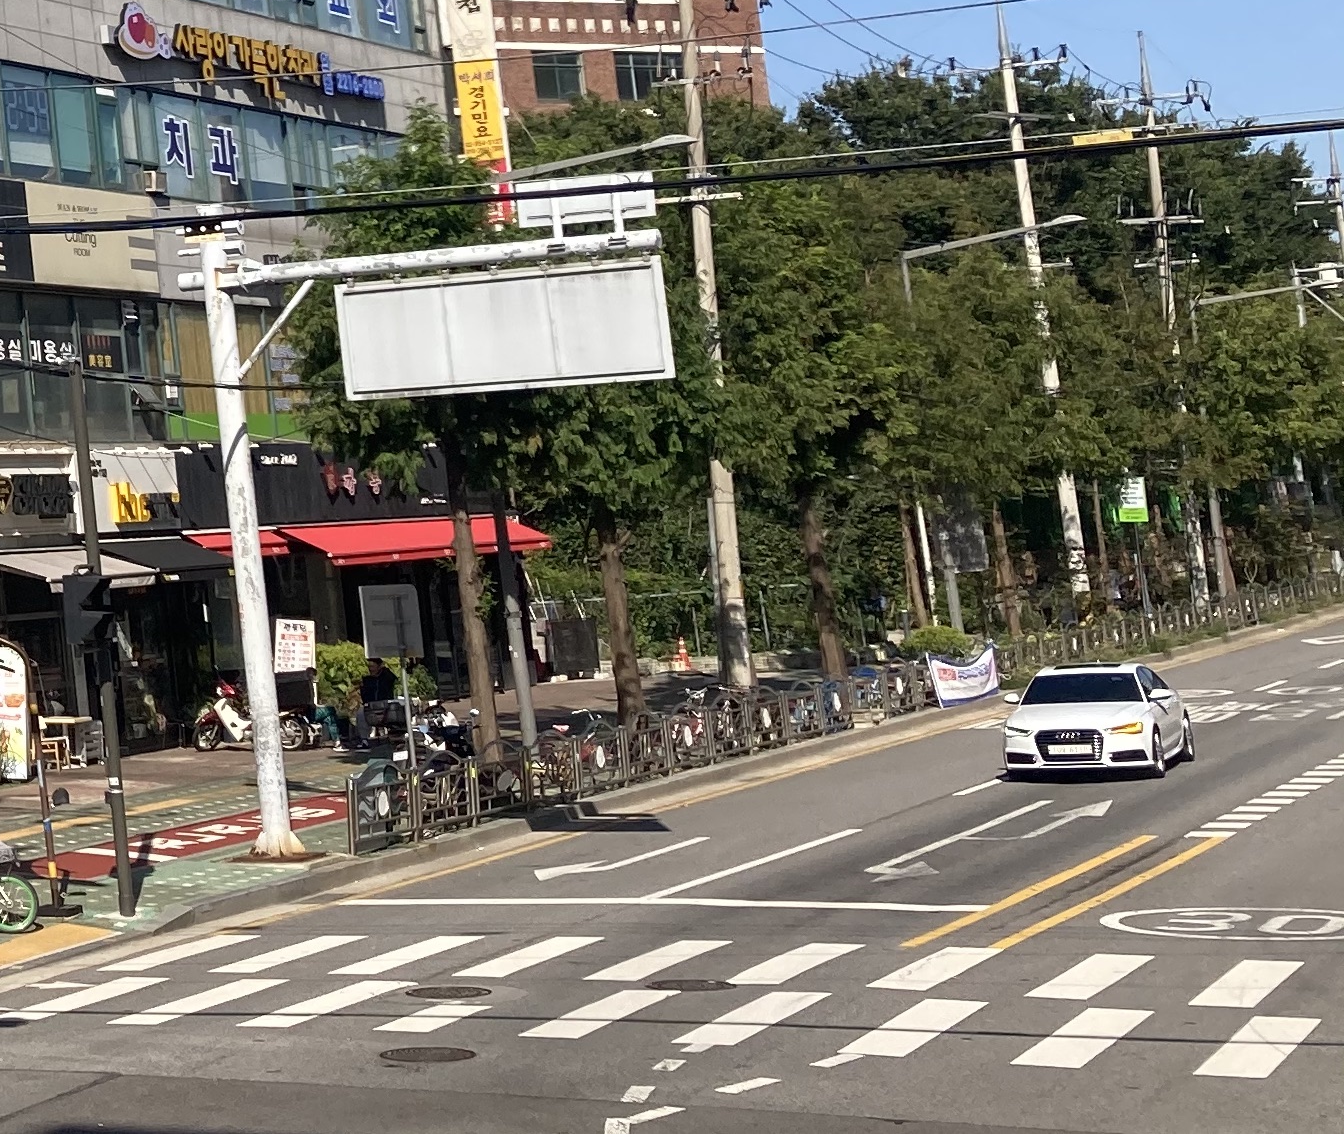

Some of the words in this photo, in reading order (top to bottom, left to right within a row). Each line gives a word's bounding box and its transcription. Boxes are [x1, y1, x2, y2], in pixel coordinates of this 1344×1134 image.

[468, 85, 493, 139] 경기민요
[163, 114, 239, 186] 치과
[1155, 911, 1343, 936] 30
